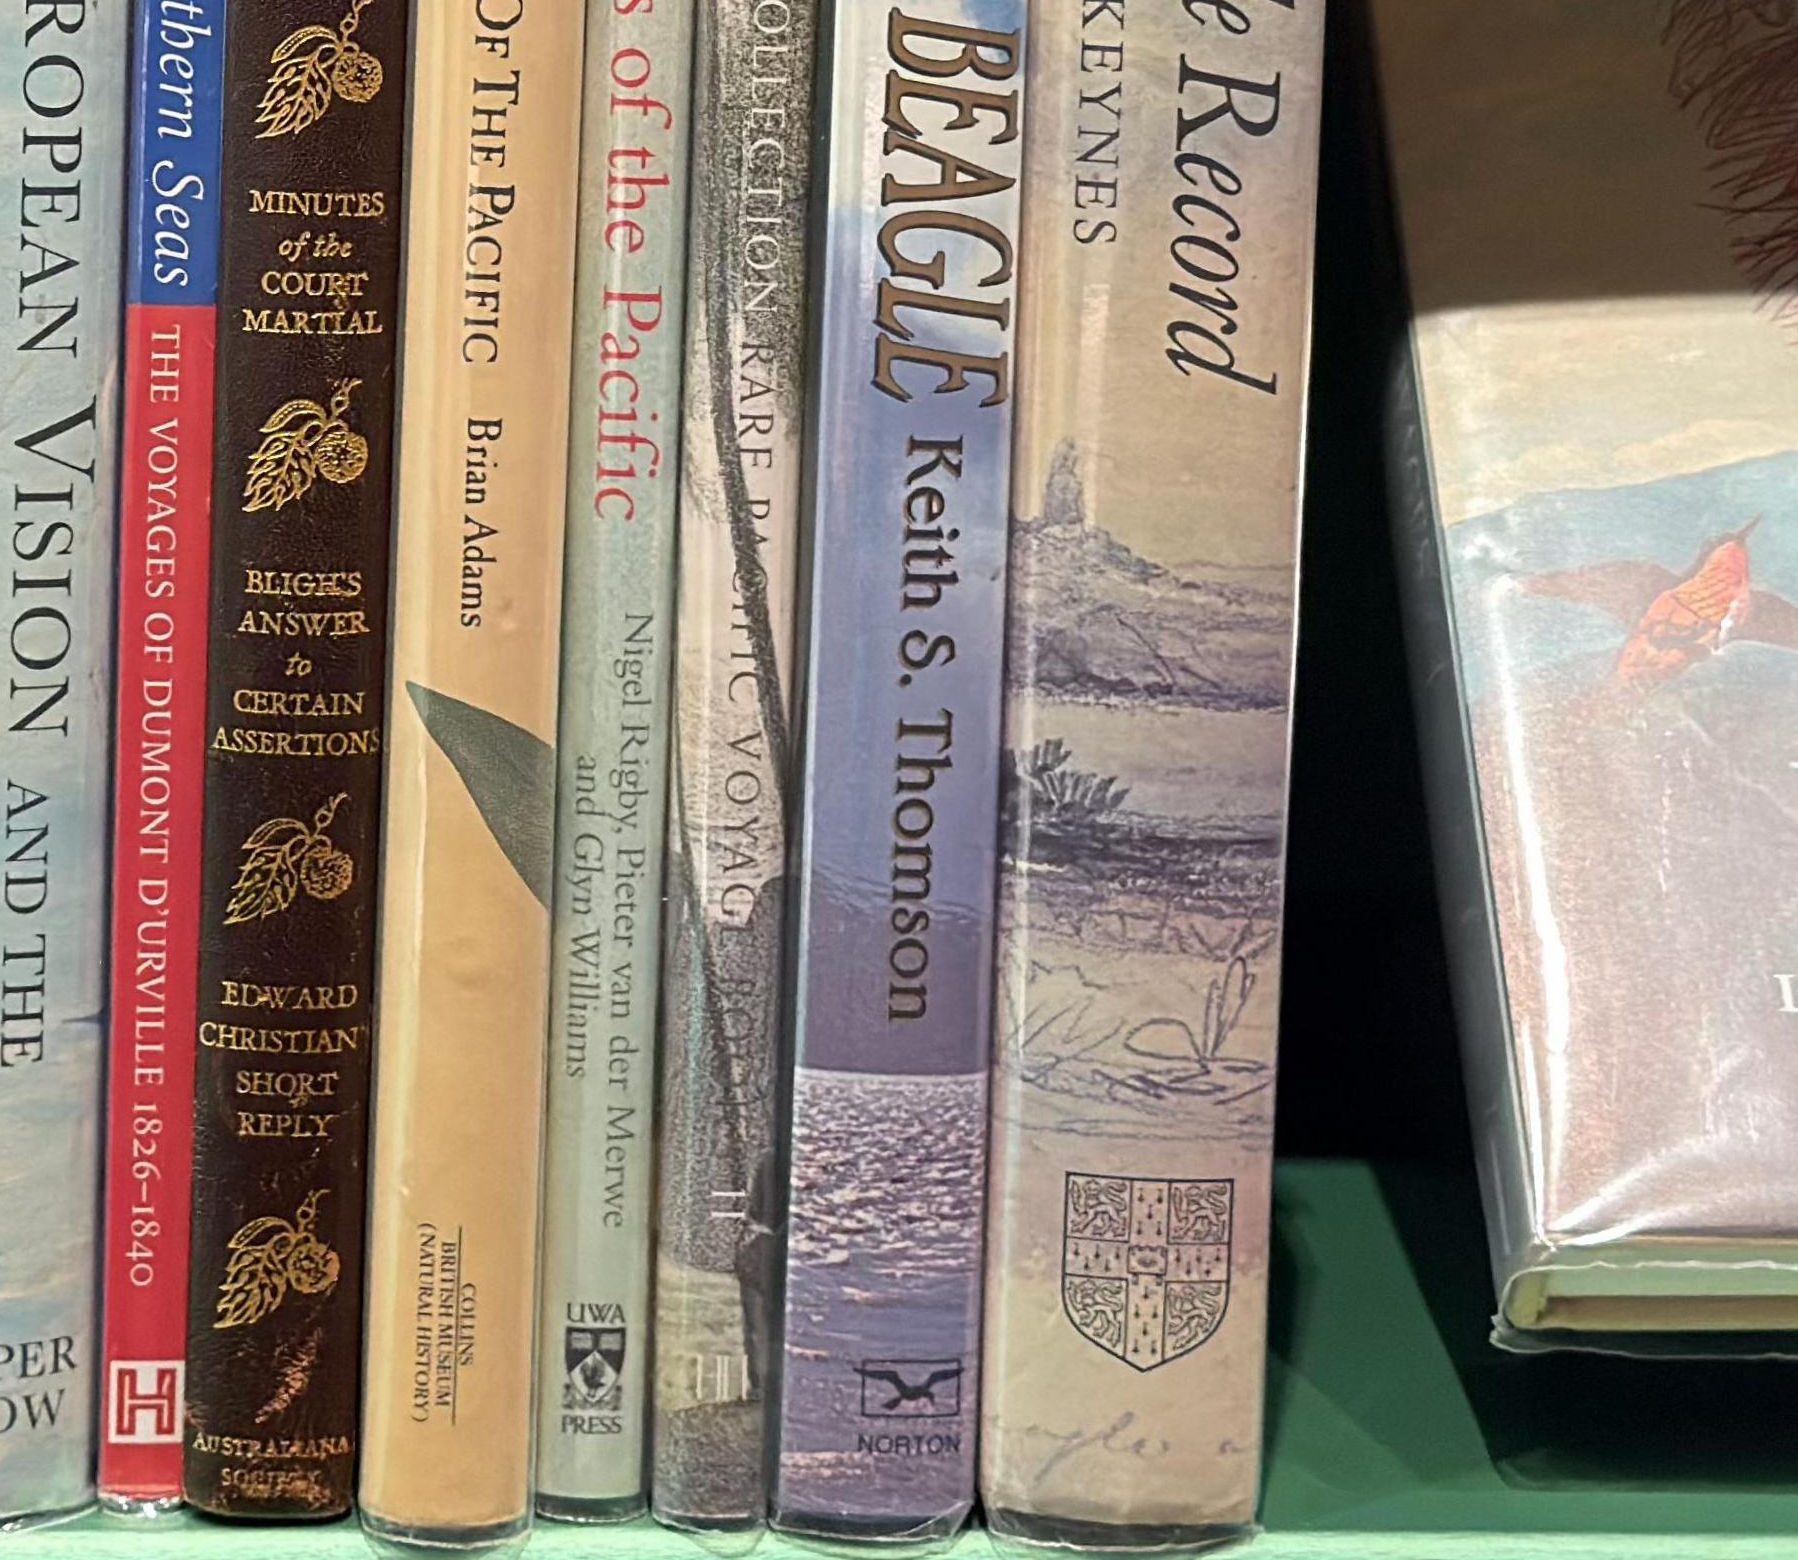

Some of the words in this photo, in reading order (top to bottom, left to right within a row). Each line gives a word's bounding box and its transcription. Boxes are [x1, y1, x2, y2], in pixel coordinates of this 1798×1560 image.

[470, 69, 522, 168] THE
[609, 47, 674, 131] of
[152, 160, 205, 287] Seas
[249, 189, 385, 217] MINUTES
[603, 146, 671, 254] the
[871, 7, 1021, 408] BEAGLE
[1165, 53, 1282, 396] Record
[261, 270, 369, 296] COURT
[278, 231, 311, 262] of
[313, 231, 353, 258] the
[462, 182, 517, 363] PACIFIC
[148, 324, 182, 403] THE
[242, 308, 383, 335] MARTIAL
[593, 285, 664, 522] Pacific
[464, 417, 503, 505] Brian
[145, 417, 180, 598] VOYAGES
[900, 433, 965, 610] Keith
[7, 394, 97, 737] VISION
[244, 568, 363, 597] BLIGH'S
[460, 513, 500, 628] Adams
[143, 611, 175, 664] OF
[237, 610, 371, 636] ANSWER
[612, 612, 655, 706] Nigel
[899, 629, 956, 687] S.
[210, 725, 381, 757] ASSERTIONS
[233, 689, 366, 717] CERTAIN
[138, 678, 173, 863] DUMONT
[574, 755, 610, 817] and
[606, 723, 651, 834] Rigby,
[4, 779, 49, 915] AND
[886, 708, 954, 1024] Thomson
[611, 847, 647, 950] Pieter
[0, 933, 47, 1068] THE
[134, 877, 170, 1087] D'URVILLE
[221, 980, 359, 1010] EDWARD
[565, 929, 601, 1079] Williams
[609, 961, 636, 1020] van
[235, 1069, 341, 1096] SHORT
[608, 1035, 640, 1091] der
[237, 1111, 340, 1138] REPLY
[602, 1104, 637, 1228] Merwe
[416, 1222, 437, 1323] (NATURAL
[437, 1241, 457, 1318] BRITISH
[566, 1302, 626, 1324] UWA
[435, 1323, 454, 1407] MUSEUM
[459, 1282, 478, 1367] COLLINS
[410, 1326, 433, 1423] HISTORY)
[561, 1415, 623, 1435] PRESS
[857, 1433, 961, 1455] NORTON
